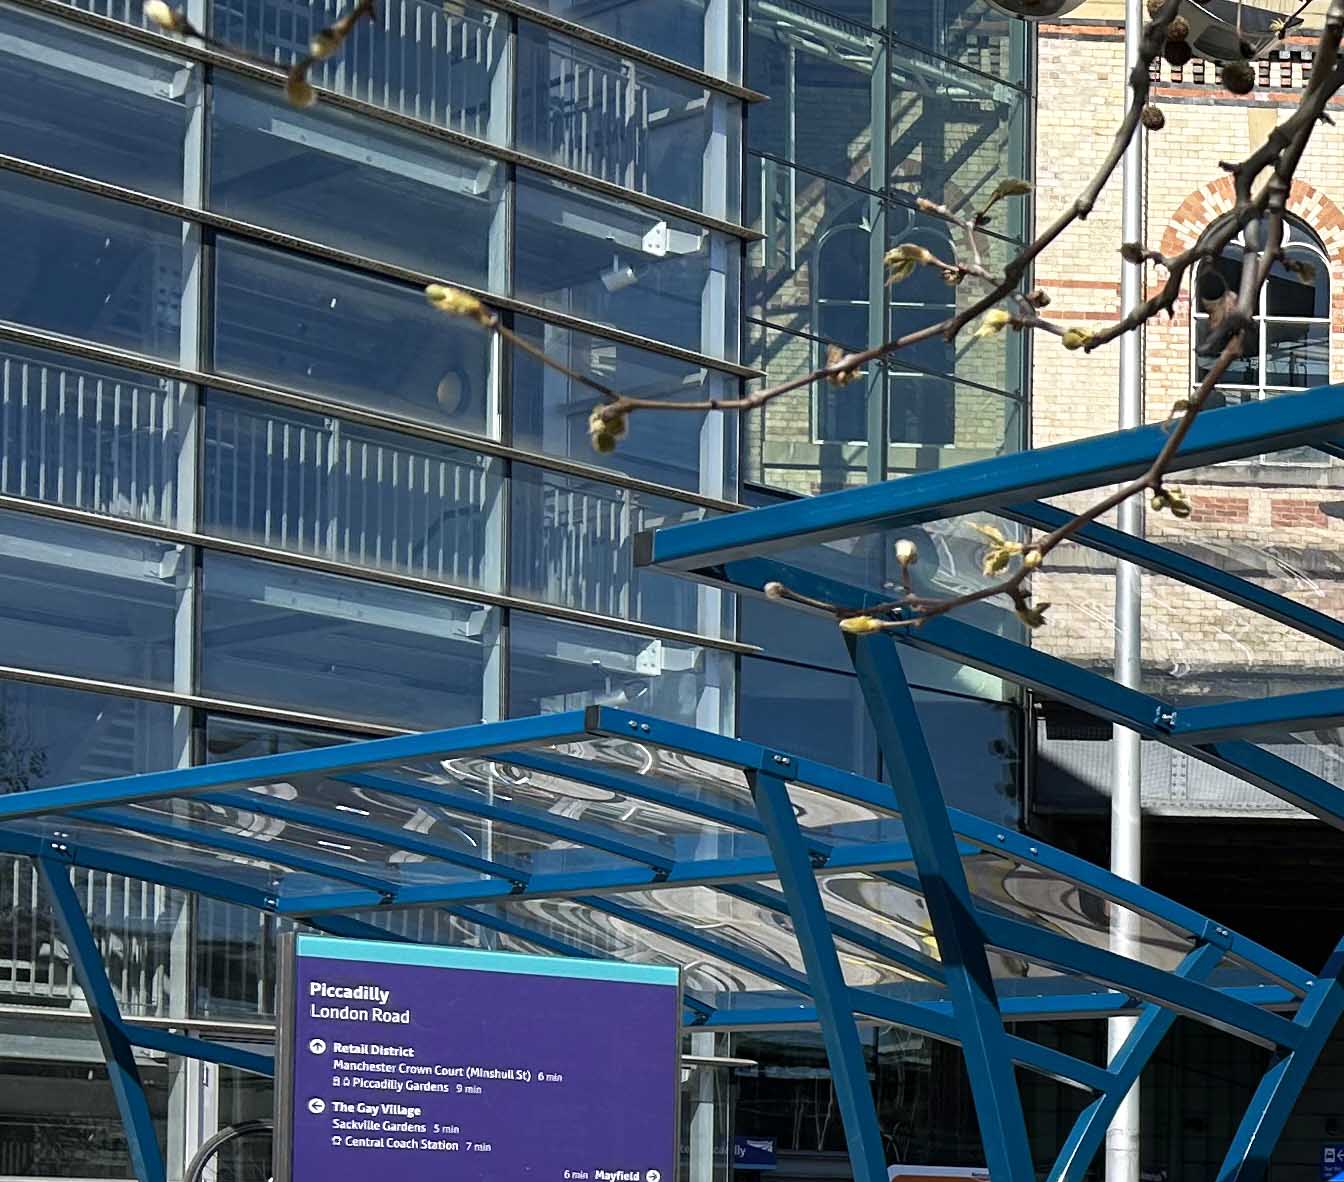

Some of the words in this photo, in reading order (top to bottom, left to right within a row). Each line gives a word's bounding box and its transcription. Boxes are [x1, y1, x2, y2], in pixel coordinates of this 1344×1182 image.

[310, 982, 390, 1004] Piccadilly
[311, 1004, 369, 1021] London
[372, 1007, 410, 1024] Road
[333, 1042, 369, 1055] Retail
[371, 1045, 415, 1057] District
[333, 1060, 396, 1073] Manchester
[398, 1063, 433, 1075] Crown
[434, 1065, 464, 1077] Court
[466, 1066, 515, 1080] (Minshull
[515, 1070, 532, 1082] St)
[537, 1072, 545, 1081] 6
[546, 1073, 563, 1082] min
[352, 1077, 403, 1092] Piccadilly
[405, 1080, 449, 1092] Gardens
[456, 1083, 463, 1093] 9
[464, 1085, 482, 1094] min
[331, 1101, 355, 1113] The
[357, 1102, 380, 1117] Gay
[380, 1103, 422, 1118] Village
[332, 1118, 381, 1131] Sackville
[382, 1120, 427, 1133] Gardens
[433, 1123, 440, 1134] 5
[442, 1125, 460, 1134] min
[345, 1135, 385, 1148] Central
[386, 1137, 419, 1149] Coach
[420, 1139, 459, 1151] Station
[465, 1141, 473, 1151] 7
[474, 1142, 492, 1152] min
[564, 1169, 571, 1180] 6
[572, 1170, 589, 1180] min
[594, 1169, 640, 1182] Mayfield
